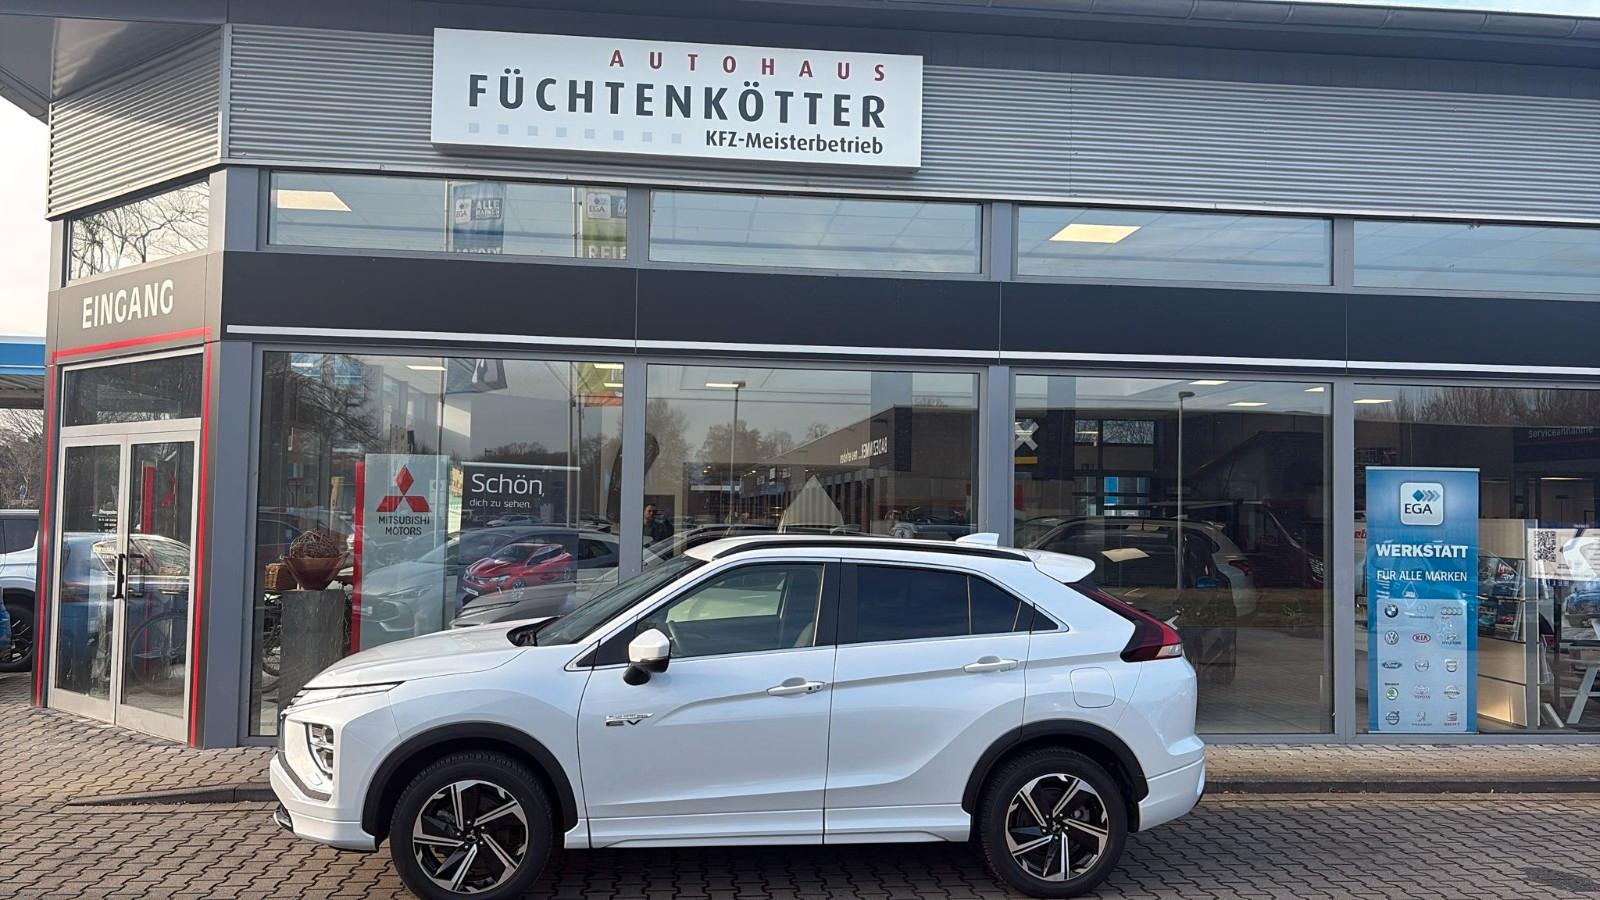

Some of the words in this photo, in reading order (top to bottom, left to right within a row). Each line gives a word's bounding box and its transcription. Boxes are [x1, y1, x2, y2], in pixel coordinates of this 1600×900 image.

[610, 49, 885, 82] AUTOHAUS
[468, 67, 886, 129] FÜCHTENKÖTTER
[705, 129, 884, 155] KFZ-Meisterbetrieb
[82, 279, 174, 329] EINGANG
[471, 473, 545, 498] Schön,
[469, 498, 488, 507] dich
[1404, 503, 1433, 515] EGA
[378, 515, 430, 525] MITSUBISHI
[385, 526, 422, 536] MOTORS
[1375, 543, 1469, 559] WERKSTATT
[1377, 567, 1397, 581] FÜR
[1399, 570, 1422, 581] ALLE
[1425, 570, 1468, 582] MARKEN
